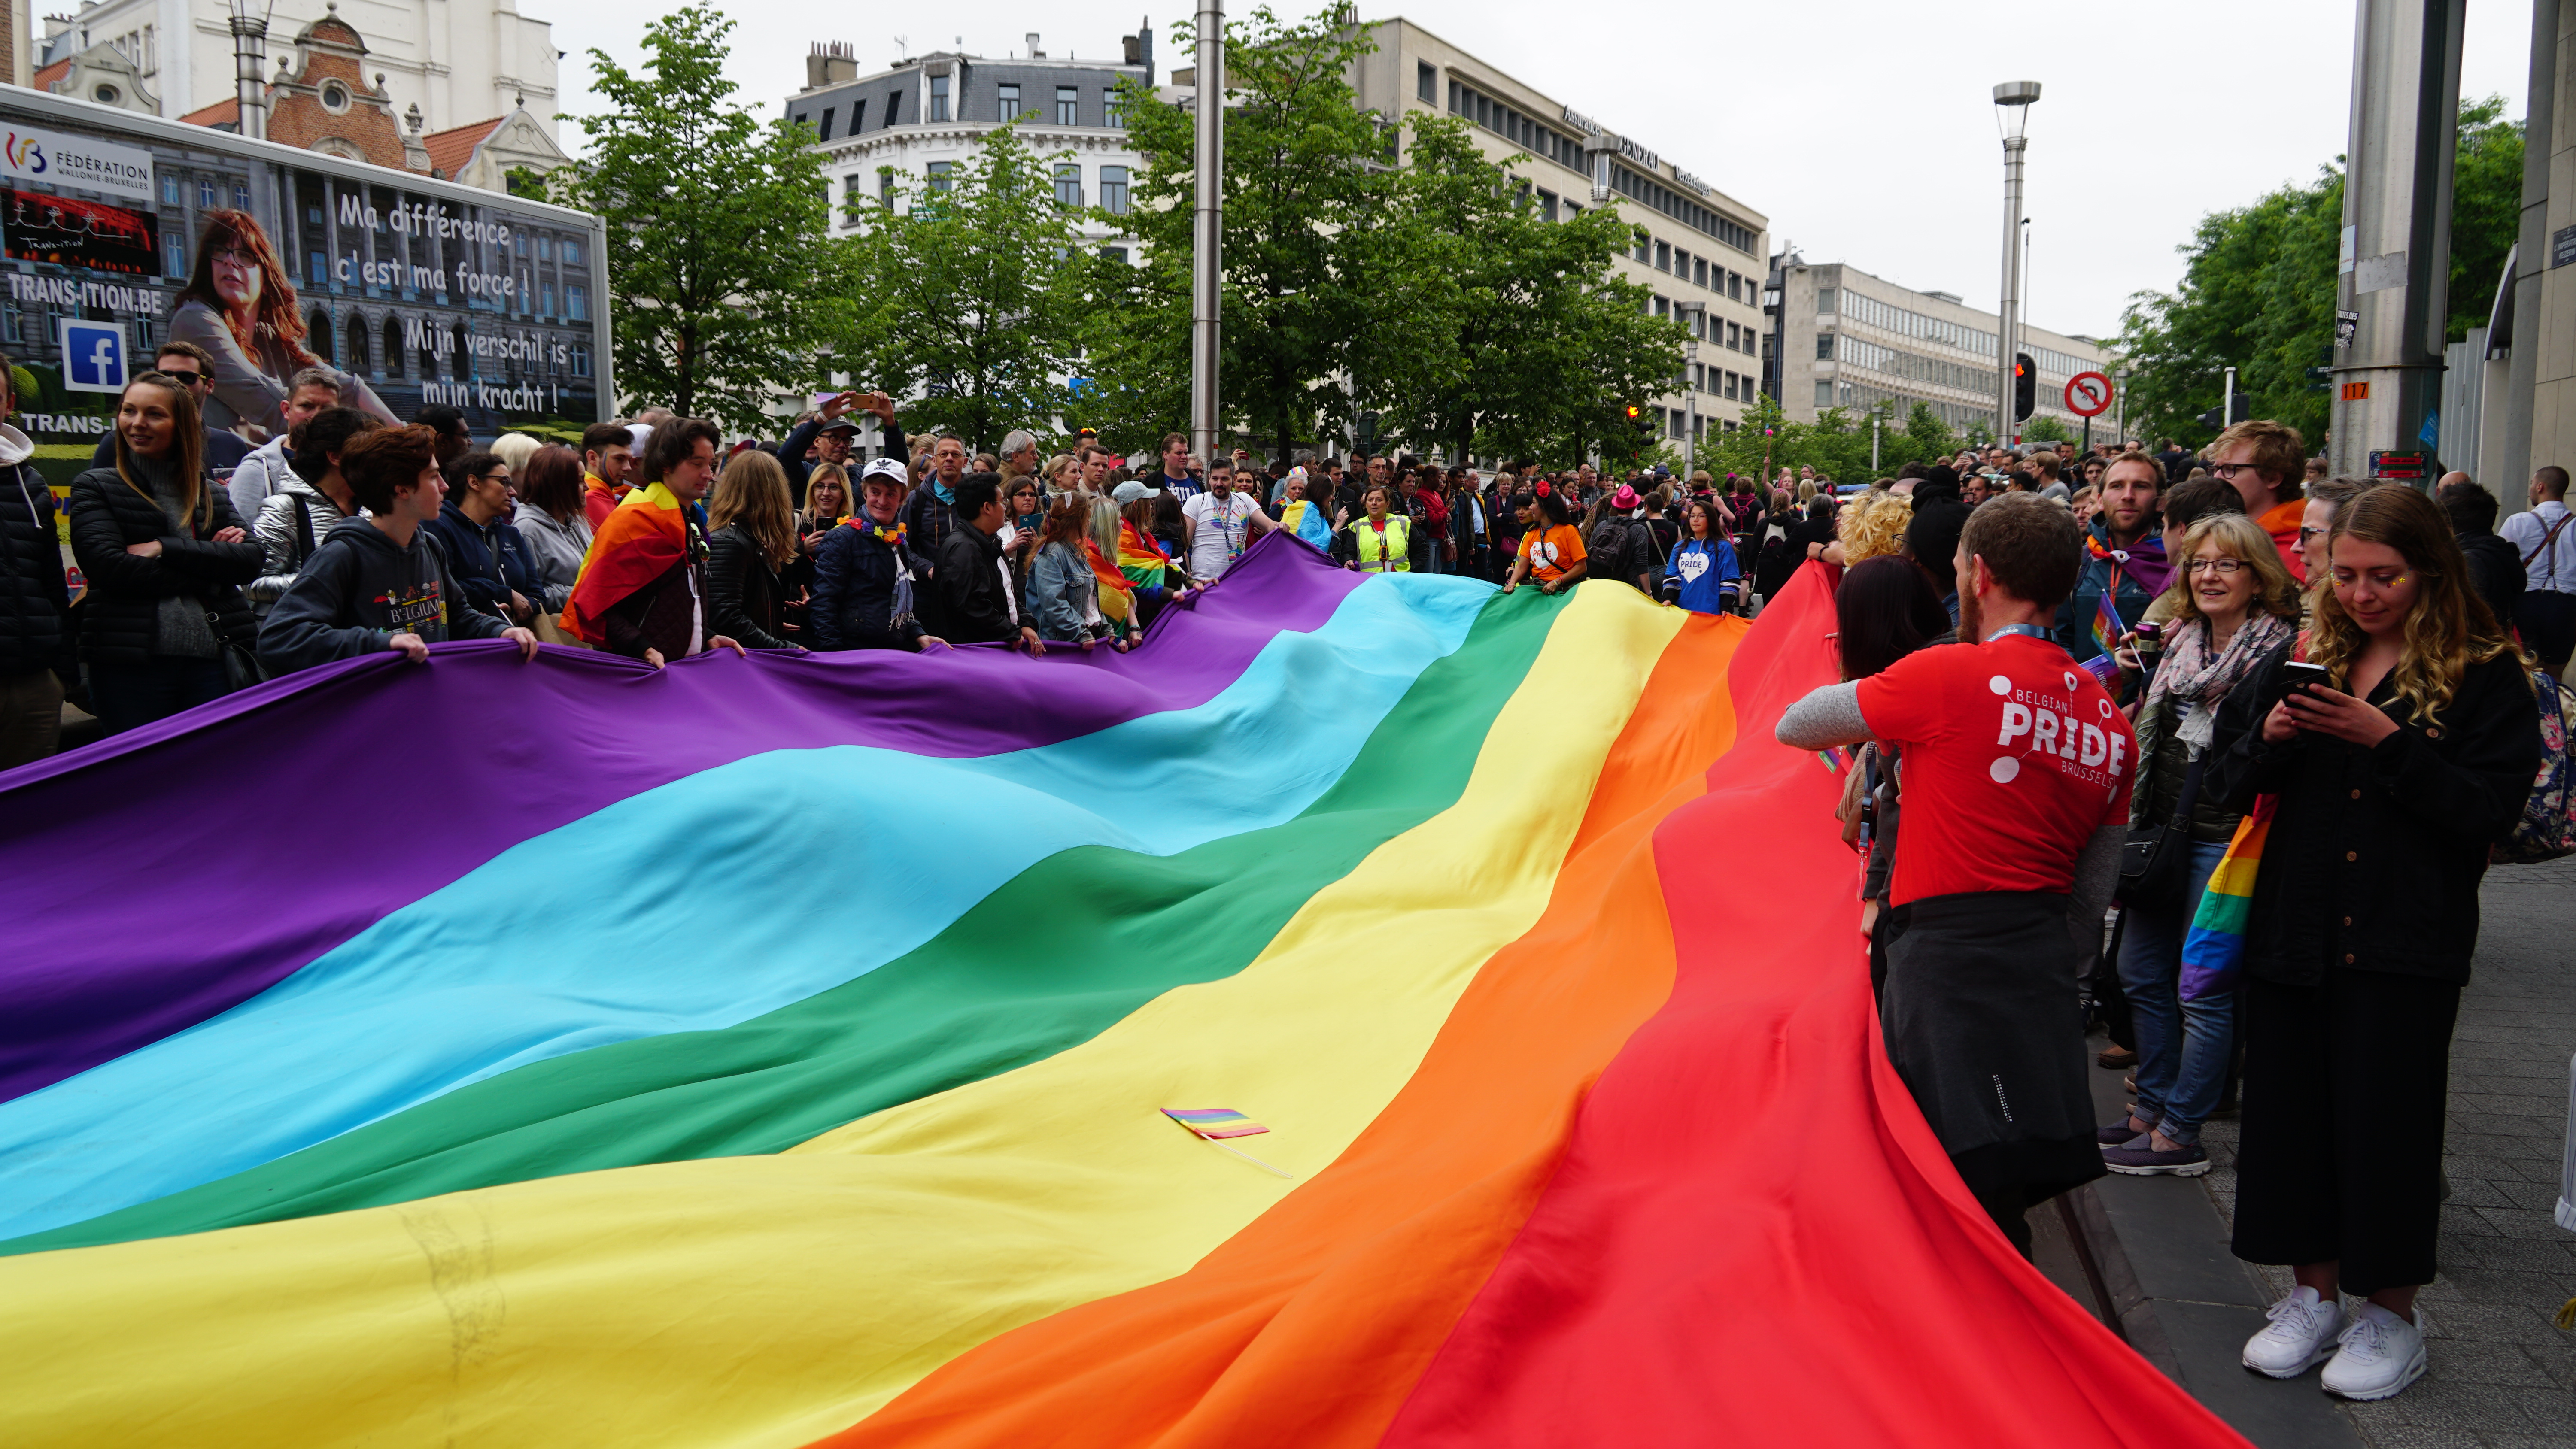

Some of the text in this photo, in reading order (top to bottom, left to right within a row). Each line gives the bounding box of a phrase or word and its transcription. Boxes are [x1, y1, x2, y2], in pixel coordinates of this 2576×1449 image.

[1564, 105, 1602, 136] Assurances
[57, 167, 149, 191] WALLONIE-BRUXELLES
[1674, 165, 1712, 197] Verzekeringen
[340, 193, 510, 246] Ma différence
[337, 249, 401, 286] c'est
[413, 264, 447, 291] ma
[456, 261, 515, 297] force
[7, 273, 163, 315] TRANS-ITION.BE
[406, 318, 567, 364] Mijn verschil is
[478, 377, 544, 412] kracht
[2344, 383, 2367, 399] 117
[1533, 549, 1552, 558] PRE
[390, 598, 440, 623] BELGIUM
[2017, 689, 2068, 714] BELGIAN
[1997, 701, 2126, 777] PRIDE
[2062, 760, 2114, 789] BRUSSELS
